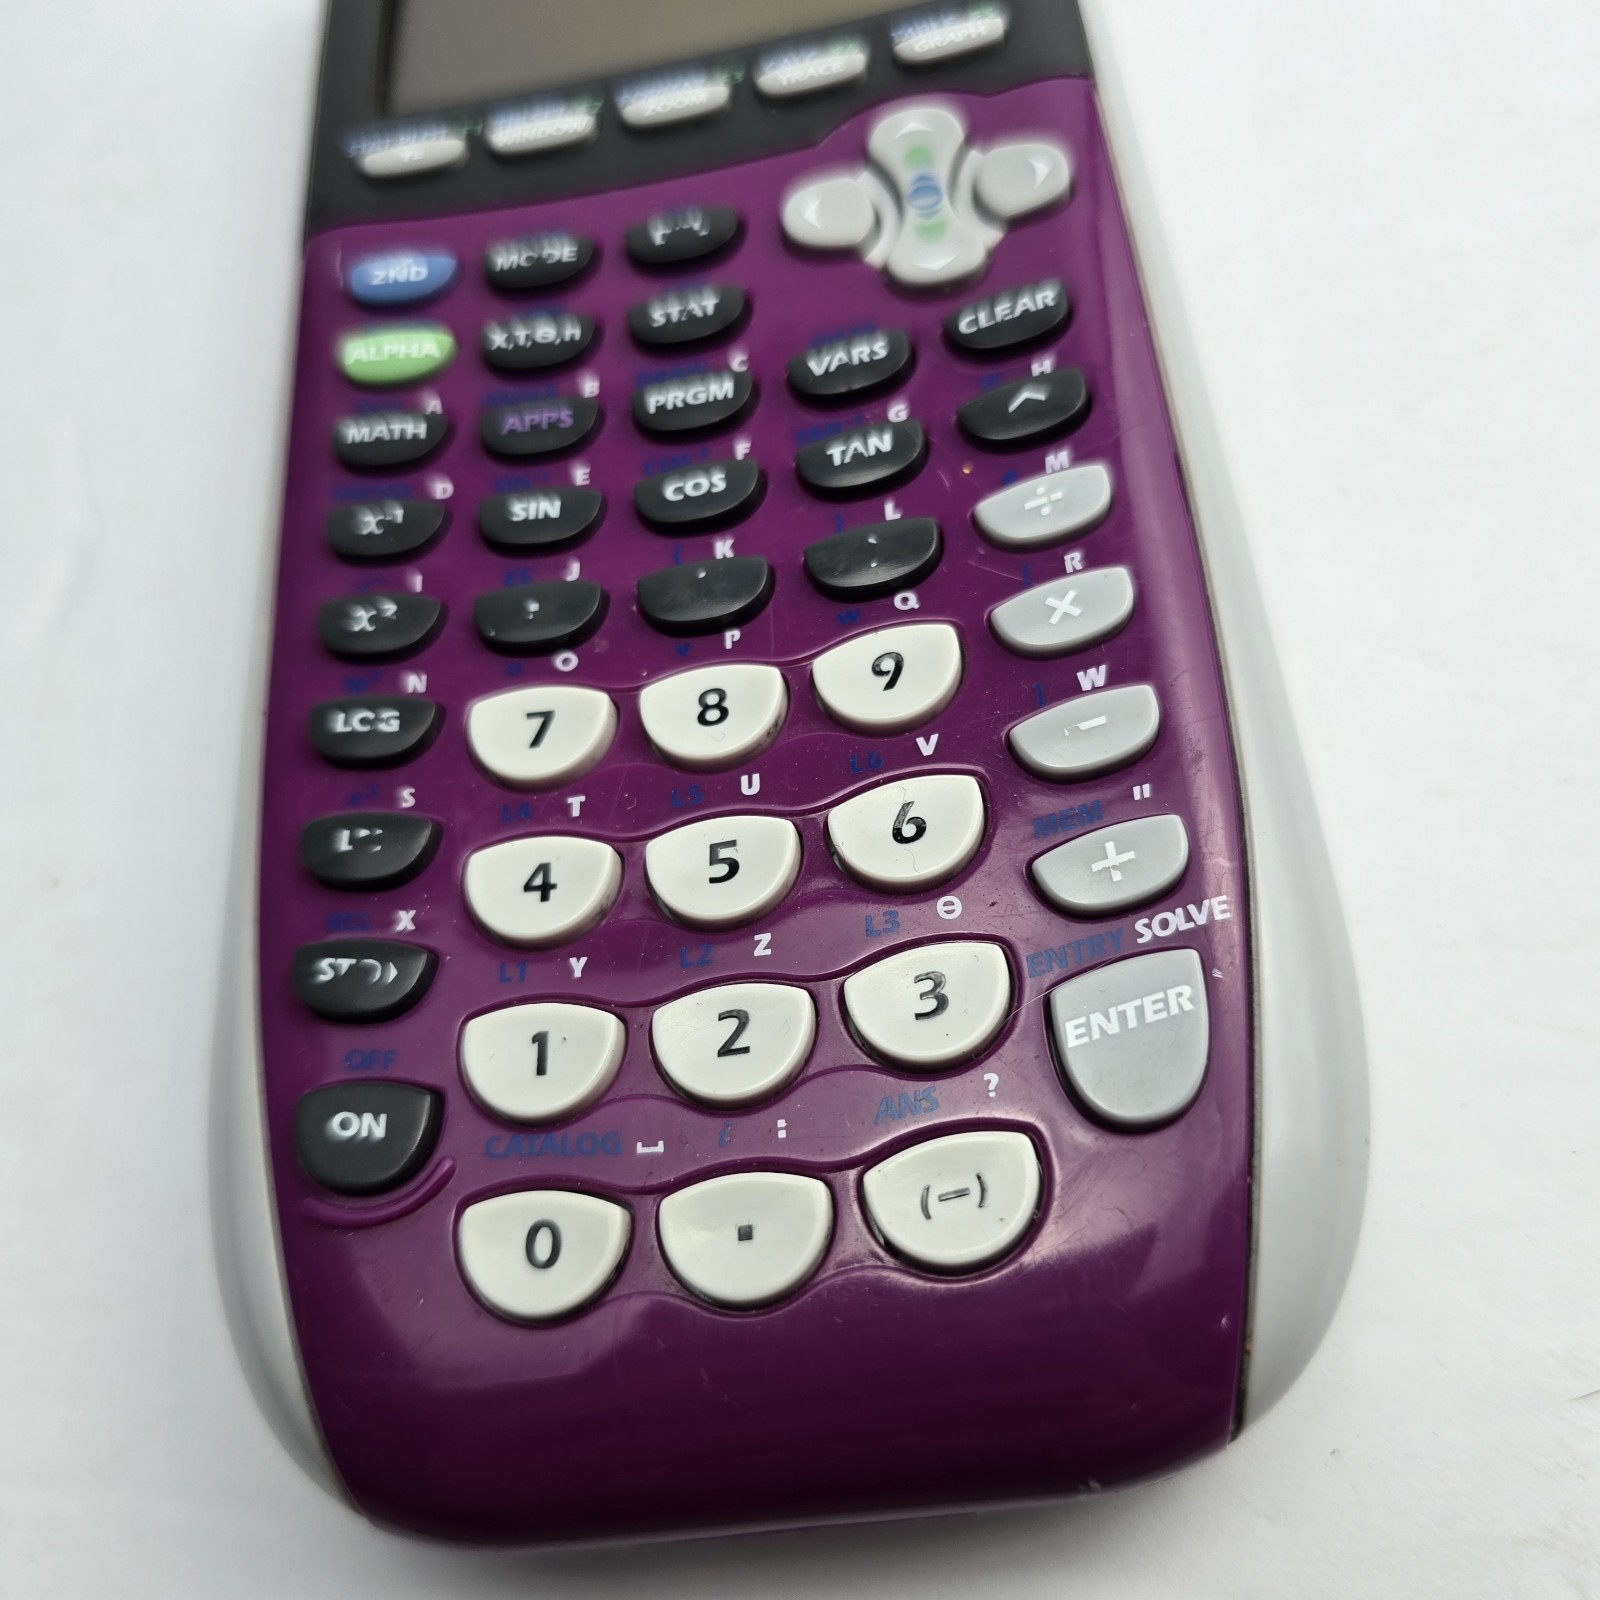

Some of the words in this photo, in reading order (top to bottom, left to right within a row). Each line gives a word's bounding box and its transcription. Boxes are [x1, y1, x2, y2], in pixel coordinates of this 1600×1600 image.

[651, 295, 720, 327] STAT
[958, 289, 1060, 334] CLEAR
[345, 339, 441, 365] ALPHA
[729, 352, 748, 372] C
[808, 340, 889, 376] VARS
[1031, 357, 1053, 377] H
[582, 378, 600, 398] B
[647, 380, 735, 414] PRGM
[425, 395, 443, 414] A
[888, 402, 909, 423] G
[346, 422, 428, 444] MATH
[501, 408, 574, 435] APPS
[735, 440, 750, 460] F
[826, 432, 892, 466] TAN
[1045, 451, 1070, 473] M
[574, 466, 591, 486] E
[664, 471, 727, 501] COS
[434, 481, 454, 500] D
[510, 498, 561, 522] SIN
[885, 502, 901, 520] L
[714, 539, 734, 559] K
[565, 560, 581, 582] J
[1064, 552, 1083, 573] R
[893, 591, 920, 610] Q
[724, 628, 741, 649] P
[406, 673, 427, 693] N
[871, 652, 904, 691] 9
[1076, 665, 1106, 691] W
[697, 688, 729, 726] 8
[526, 710, 555, 749] 7
[916, 733, 938, 756] V
[741, 774, 760, 795] U
[400, 788, 415, 808] S
[567, 796, 585, 817] T
[892, 801, 926, 844] 6
[1033, 799, 1103, 840] MEM
[708, 839, 739, 884] 5
[523, 862, 557, 902] 4
[397, 909, 416, 930] X
[865, 910, 899, 937] L3
[1135, 896, 1231, 944] SOLVE
[679, 944, 714, 969] L2
[753, 933, 772, 956] Z
[1027, 928, 1123, 978] ENTRY
[570, 957, 588, 978] Y
[914, 971, 949, 1020] 3
[1065, 984, 1195, 1049] ENTER
[717, 1009, 750, 1057] 2
[531, 1030, 549, 1076] 1
[874, 1087, 939, 1124] ANS
[332, 1111, 387, 1139] ON
[484, 1131, 623, 1160] CATALOG
[525, 1219, 561, 1269] 0
